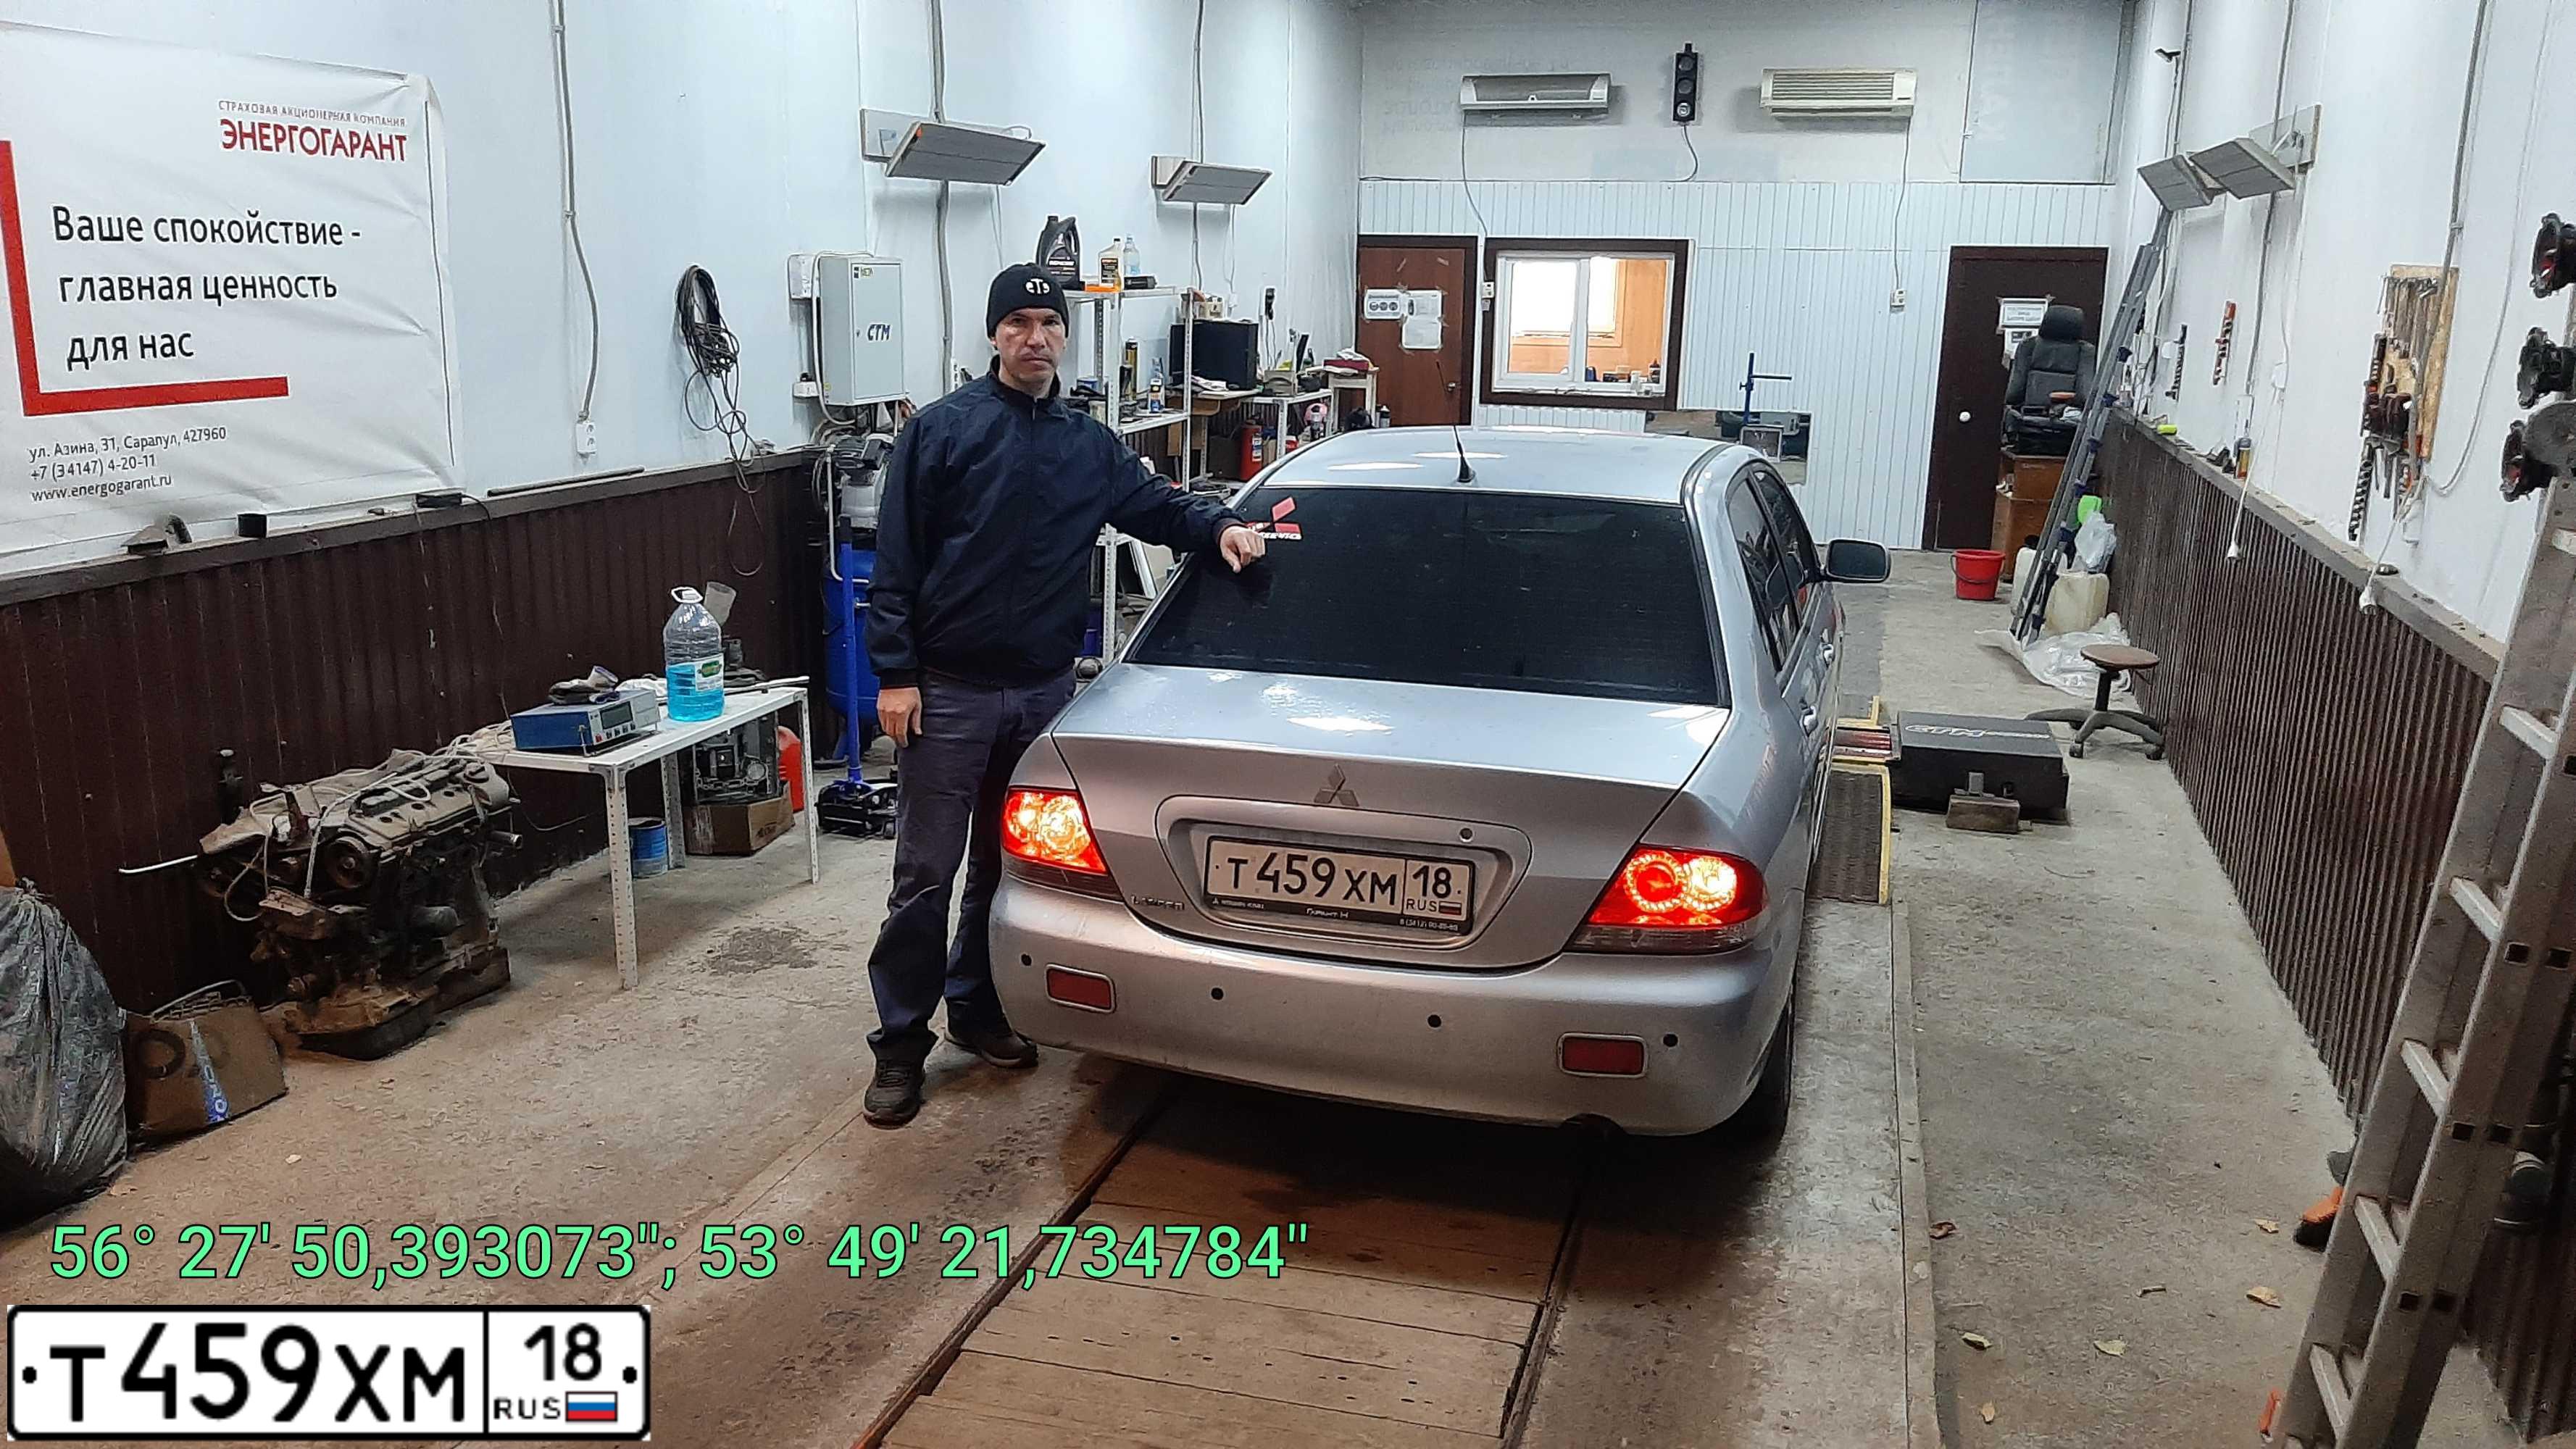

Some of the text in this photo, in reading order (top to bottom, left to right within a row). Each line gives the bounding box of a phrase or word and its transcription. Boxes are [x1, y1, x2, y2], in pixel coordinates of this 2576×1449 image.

[218, 100, 406, 128] СТРАХОВАЯ АКЦИОНЕРНАЯ КОМПАНИЯ
[220, 118, 407, 162] ЭНЕРГОГАРАНТ
[52, 205, 143, 243] Ваше
[154, 209, 343, 246] спокойствие
[59, 273, 338, 306] главная ценность
[66, 330, 195, 372] для нас
[28, 426, 227, 464] ул. Азина, 31, Сарапул, 427960
[30, 453, 156, 483] +7 (34147) 4-20-11
[31, 474, 172, 502] www.energogarant.ru
[1412, 864, 1452, 899] 18
[1406, 898, 1438, 913] RUS
